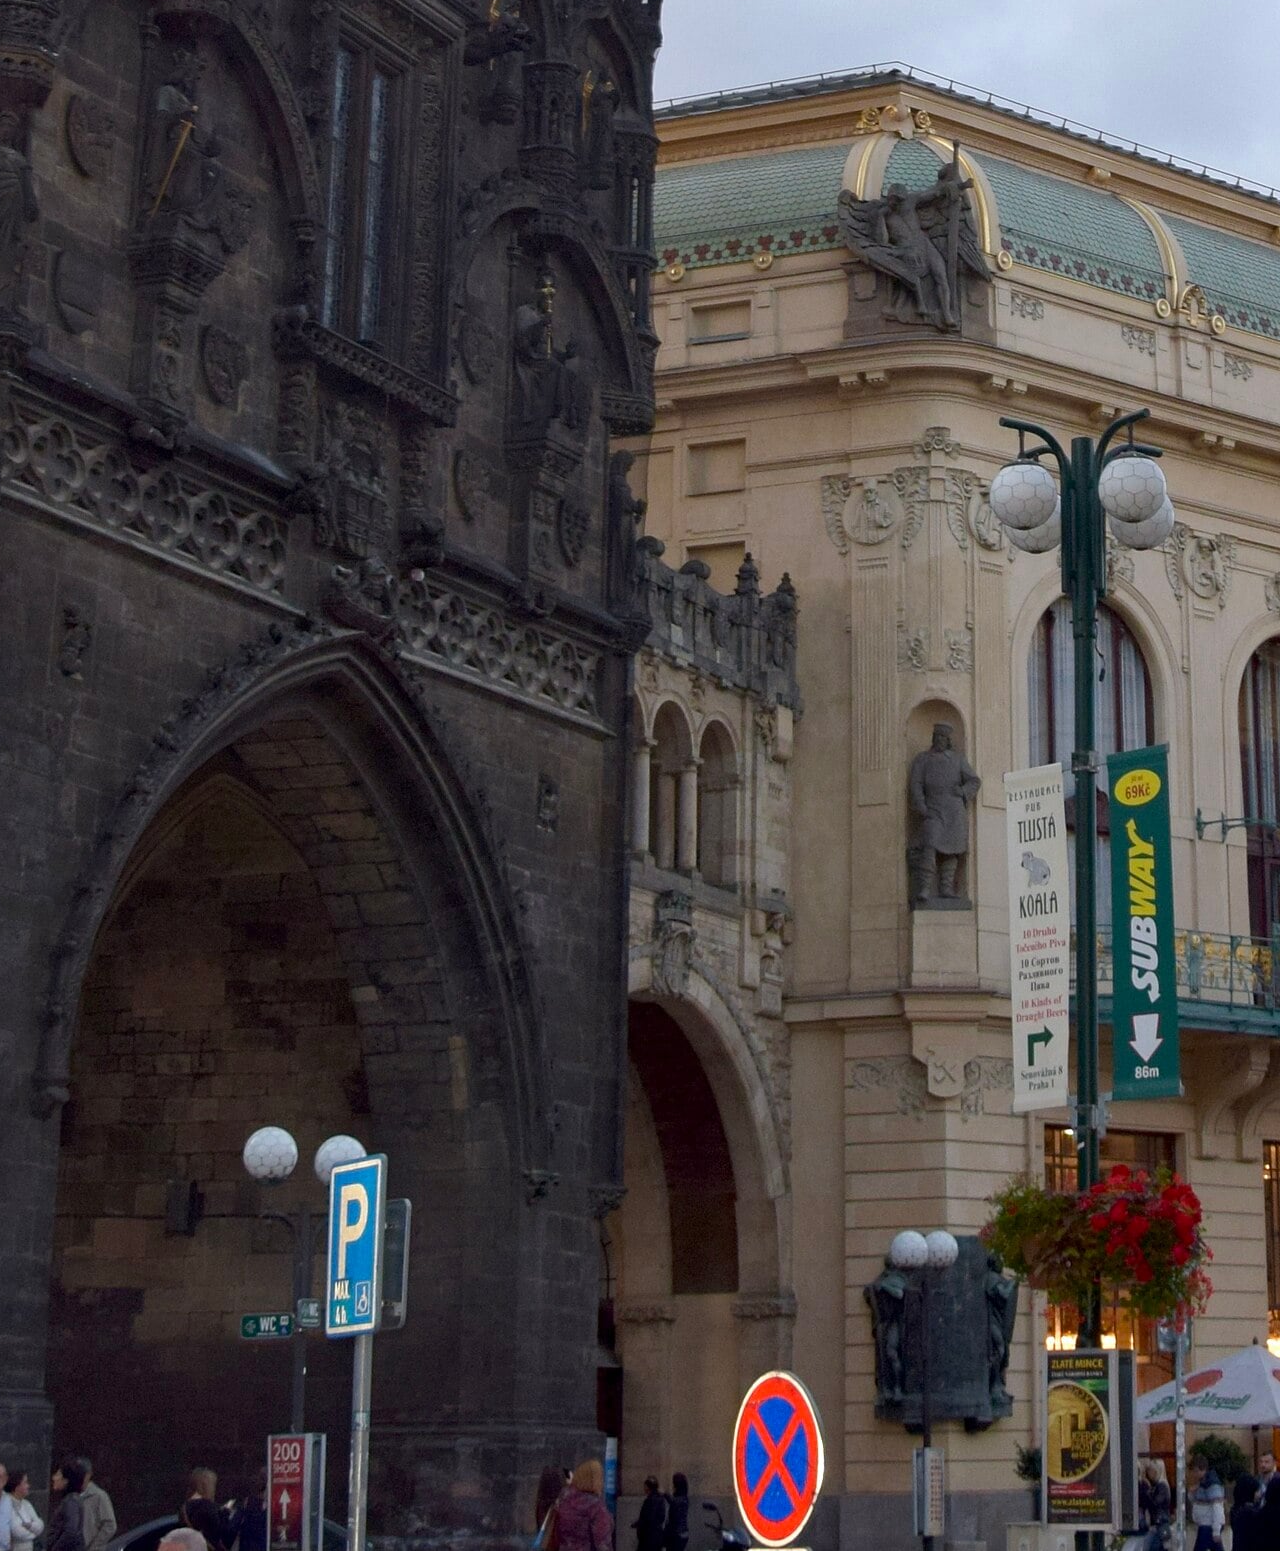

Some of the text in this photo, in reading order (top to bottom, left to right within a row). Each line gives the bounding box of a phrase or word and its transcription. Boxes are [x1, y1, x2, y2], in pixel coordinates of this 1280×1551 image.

[1009, 783, 1062, 802] RESTAURACE
[1125, 783, 1151, 800] 69Kč
[1025, 801, 1041, 813] PUB
[1018, 812, 1057, 844] TLUSTÁ
[1020, 890, 1058, 919] KOALA
[1125, 818, 1162, 1004] SUBWAY
[1023, 926, 1057, 939] 10 Druhů
[1049, 939, 1066, 949] Piva
[1021, 959, 1029, 968] 10
[1021, 993, 1063, 1009] 10 Kinds of
[1016, 1009, 1067, 1023] Draught Beers
[1058, 1065, 1064, 1075] 8
[1134, 1065, 1160, 1079] 86m
[1029, 1079, 1049, 1090] Praha
[337, 1183, 369, 1280] P
[334, 1280, 350, 1301] MAX.
[335, 1306, 341, 1325] 4
[259, 1316, 277, 1332] WC
[1075, 1358, 1104, 1368] MINCE
[273, 1442, 300, 1461] 200
[272, 1462, 300, 1474] SHOPS
